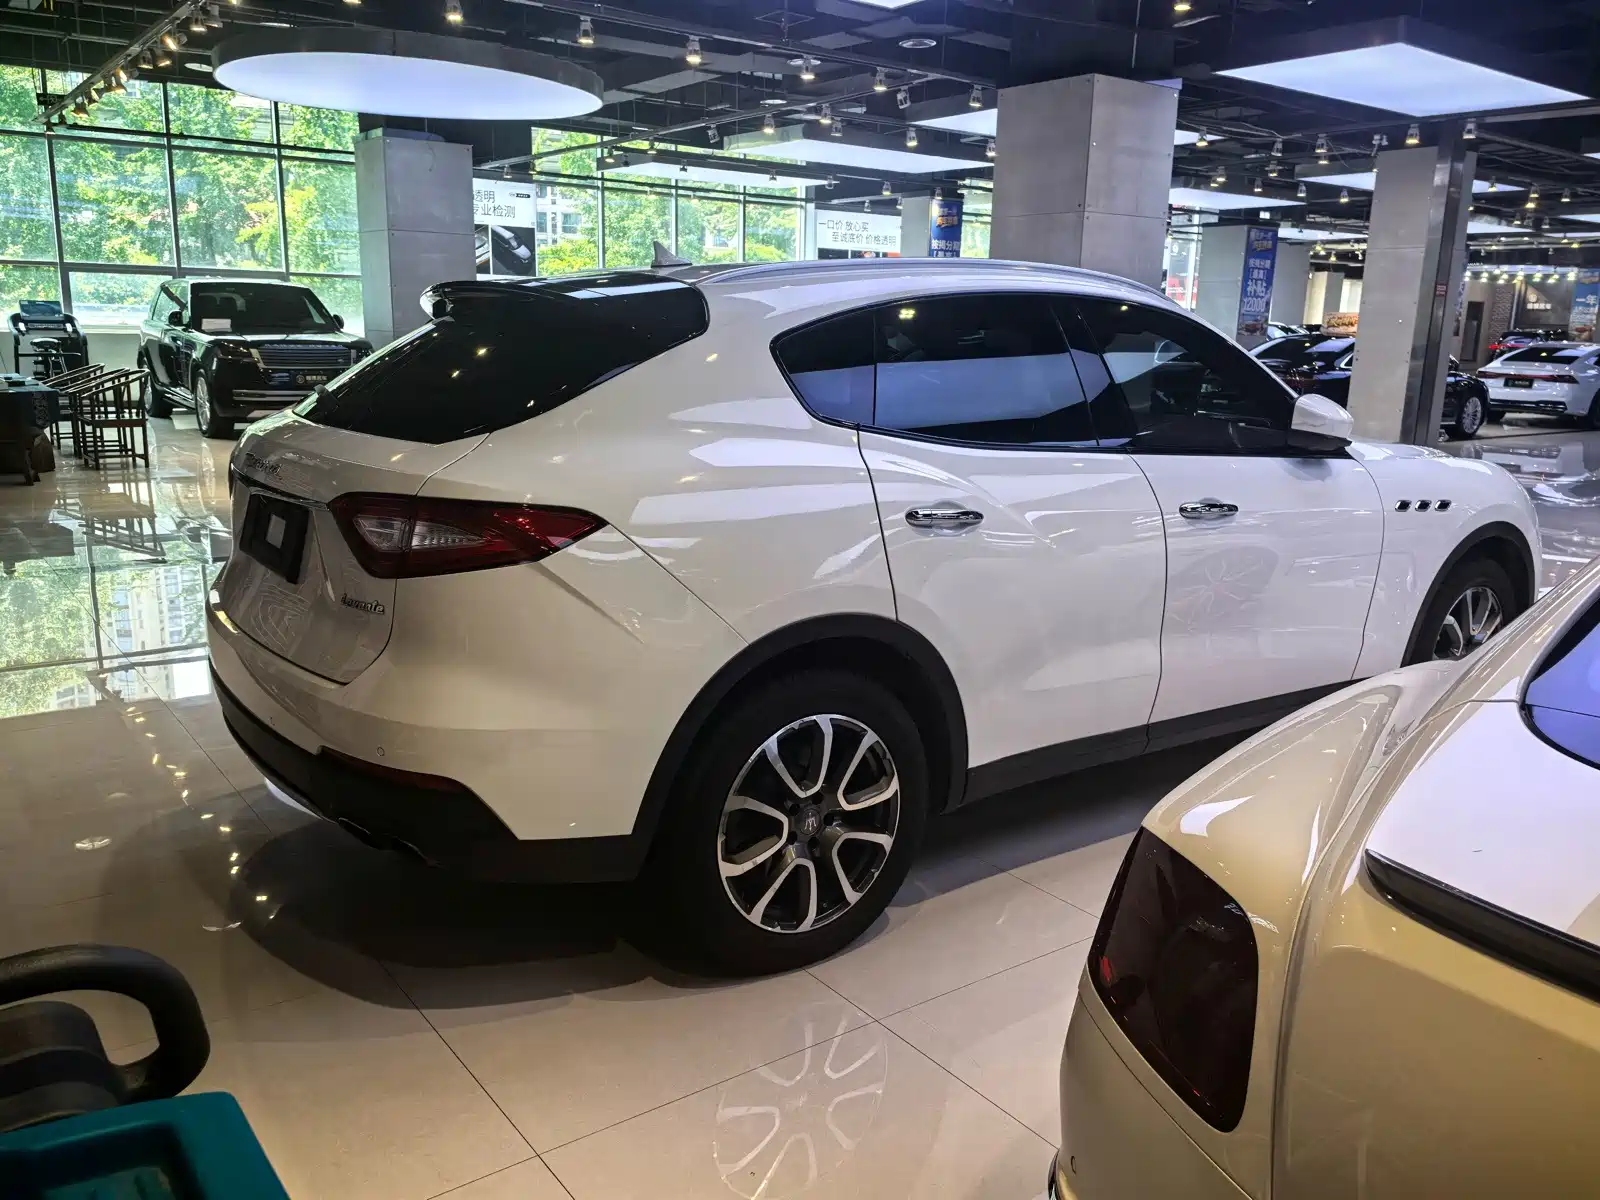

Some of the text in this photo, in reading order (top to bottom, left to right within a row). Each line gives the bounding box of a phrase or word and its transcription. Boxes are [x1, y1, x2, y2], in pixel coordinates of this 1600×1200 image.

[475, 190, 495, 203] 透明
[818, 219, 869, 232] 一口价 放心买
[831, 231, 897, 248] 至诚底价 价格透明
[1247, 280, 1267, 297] 补贴
